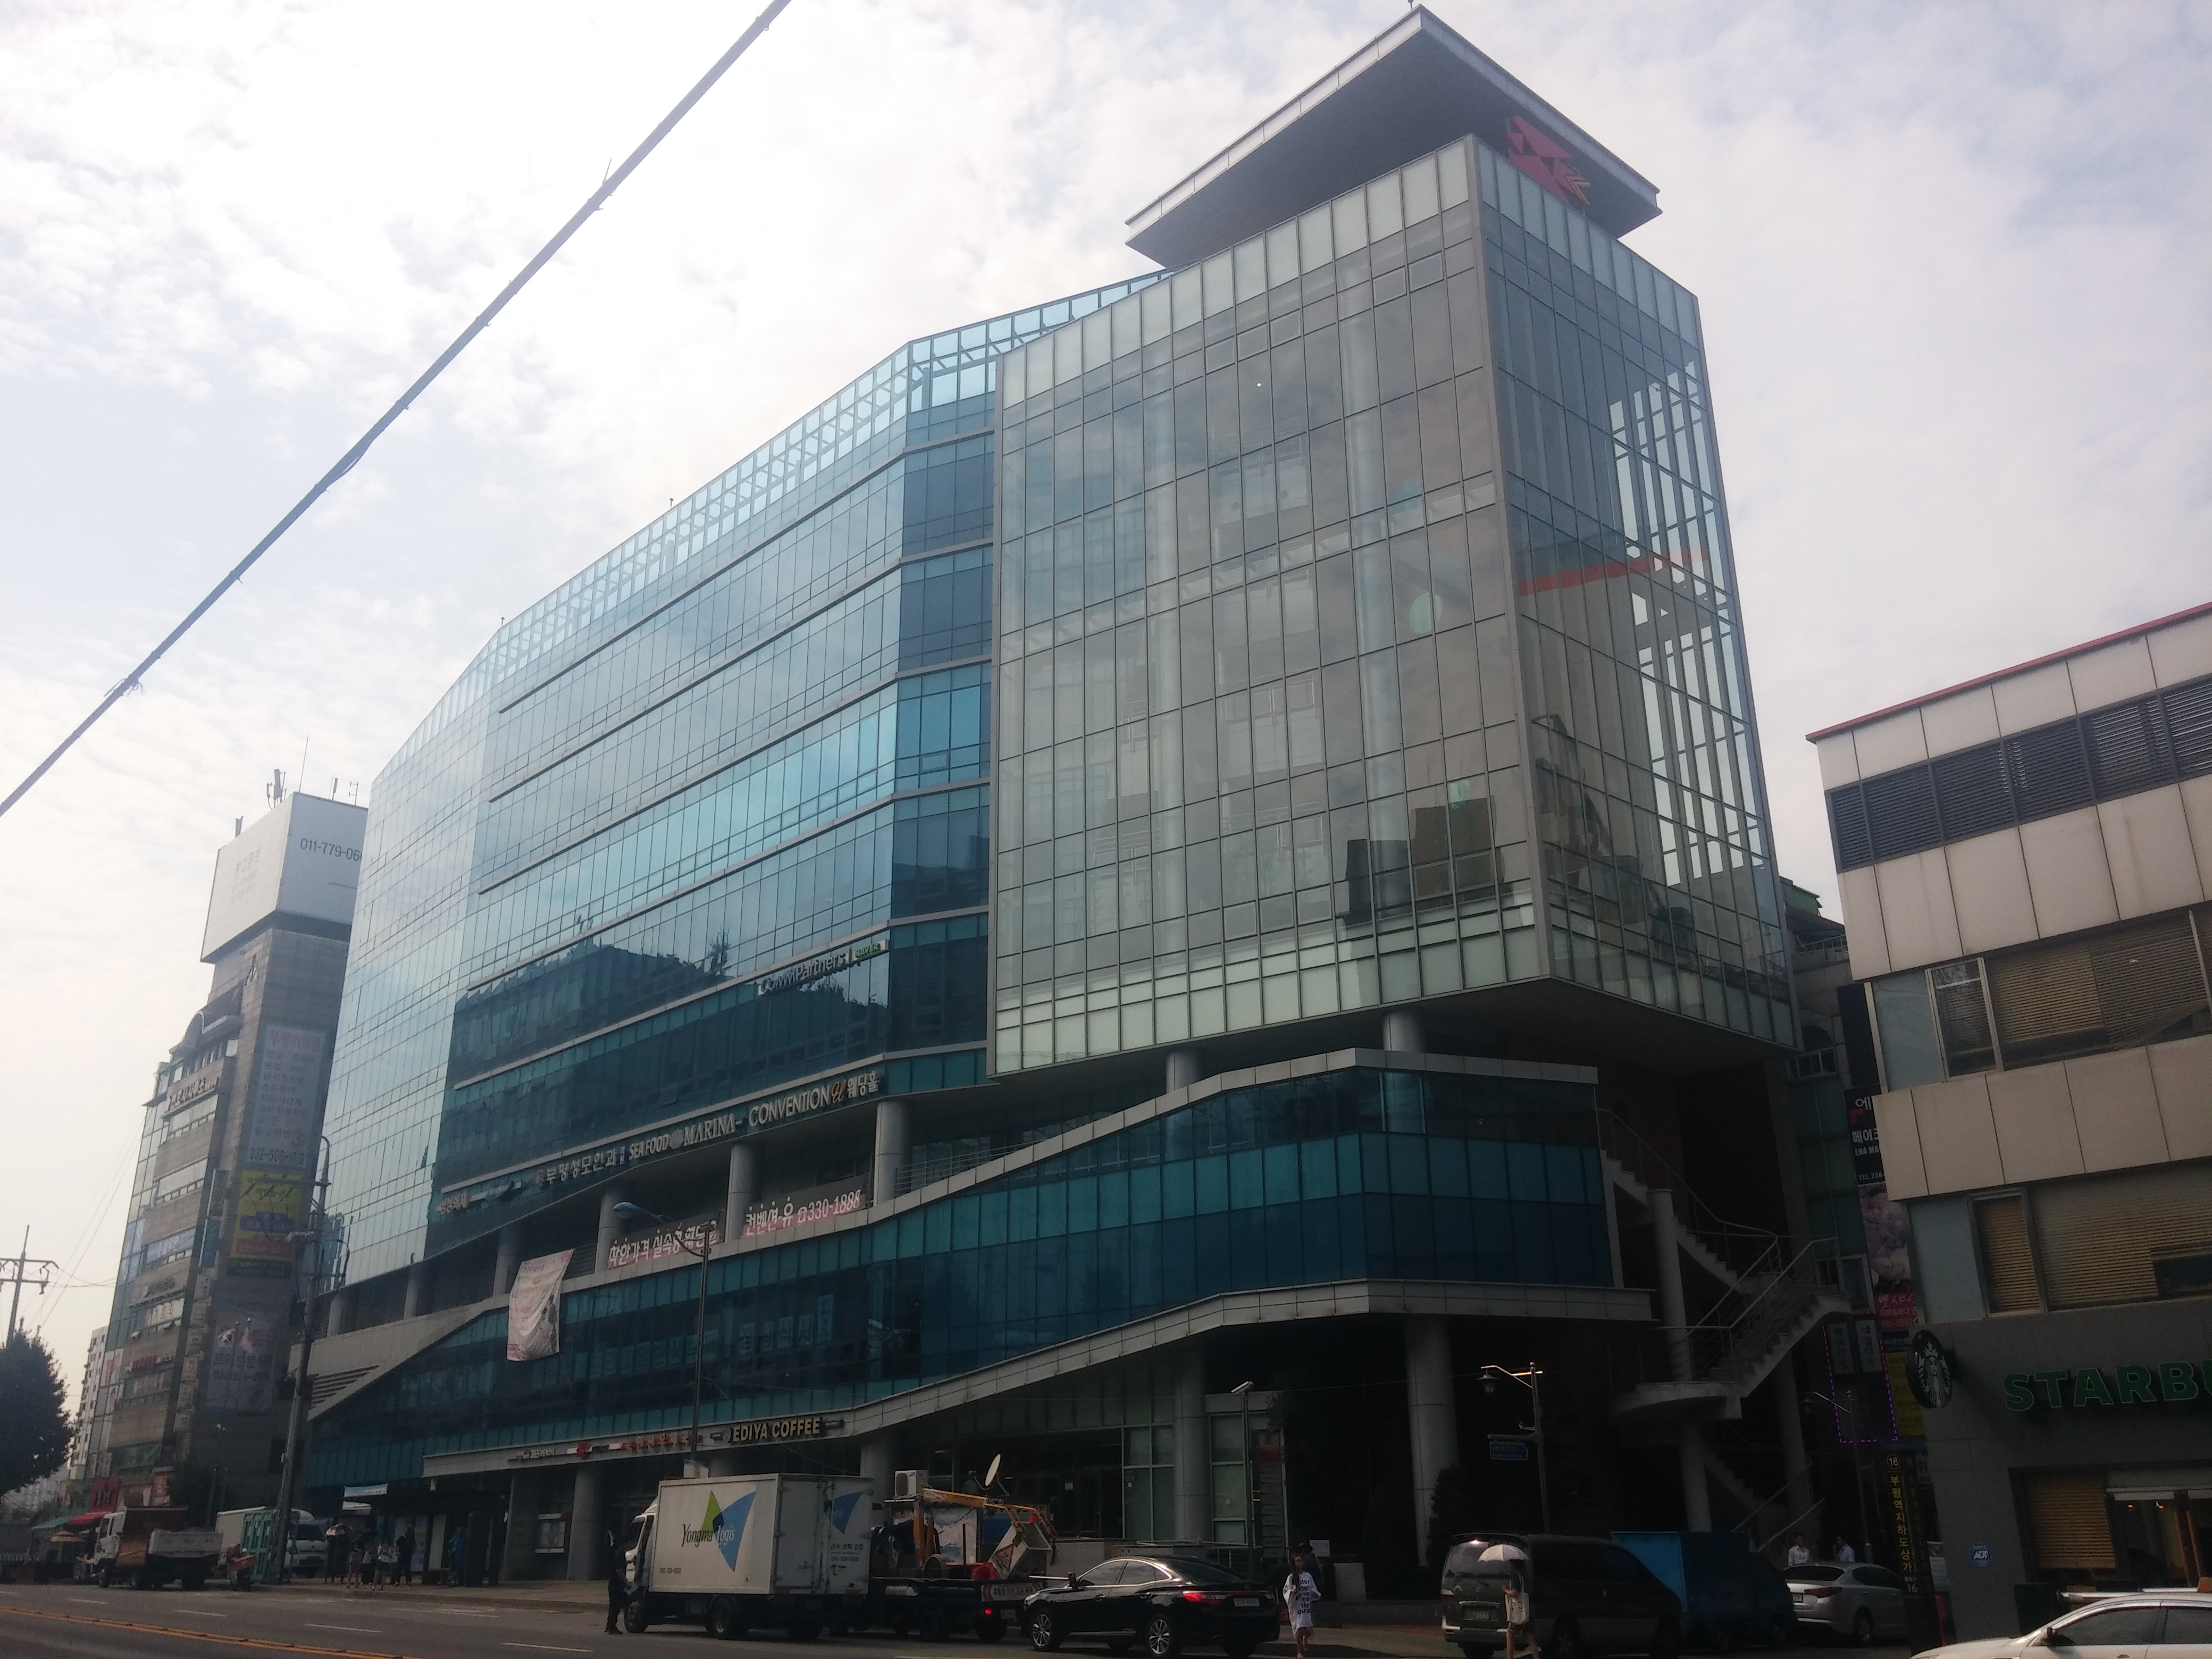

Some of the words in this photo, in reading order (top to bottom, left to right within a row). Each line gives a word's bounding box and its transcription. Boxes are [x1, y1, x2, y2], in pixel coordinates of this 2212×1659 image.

[855, 942, 881, 959] NAVER
[749, 1085, 831, 1127] CONVENTION
[847, 1071, 879, 1099] 웨딩홀
[683, 1113, 736, 1147] MARINA
[546, 1147, 617, 1185] 부평성모안과
[807, 1189, 862, 1221] 330-1888
[609, 1237, 650, 1267] 착한가격
[733, 1423, 768, 1443] EDIYA
[772, 1417, 822, 1439] COFFEE
[1889, 1457, 1899, 1467] 16
[682, 1523, 713, 1548] Yongma
[716, 1525, 735, 1546] Logis
[1974, 1550, 1988, 1561] ADT
[1907, 1584, 1917, 1593] 16
